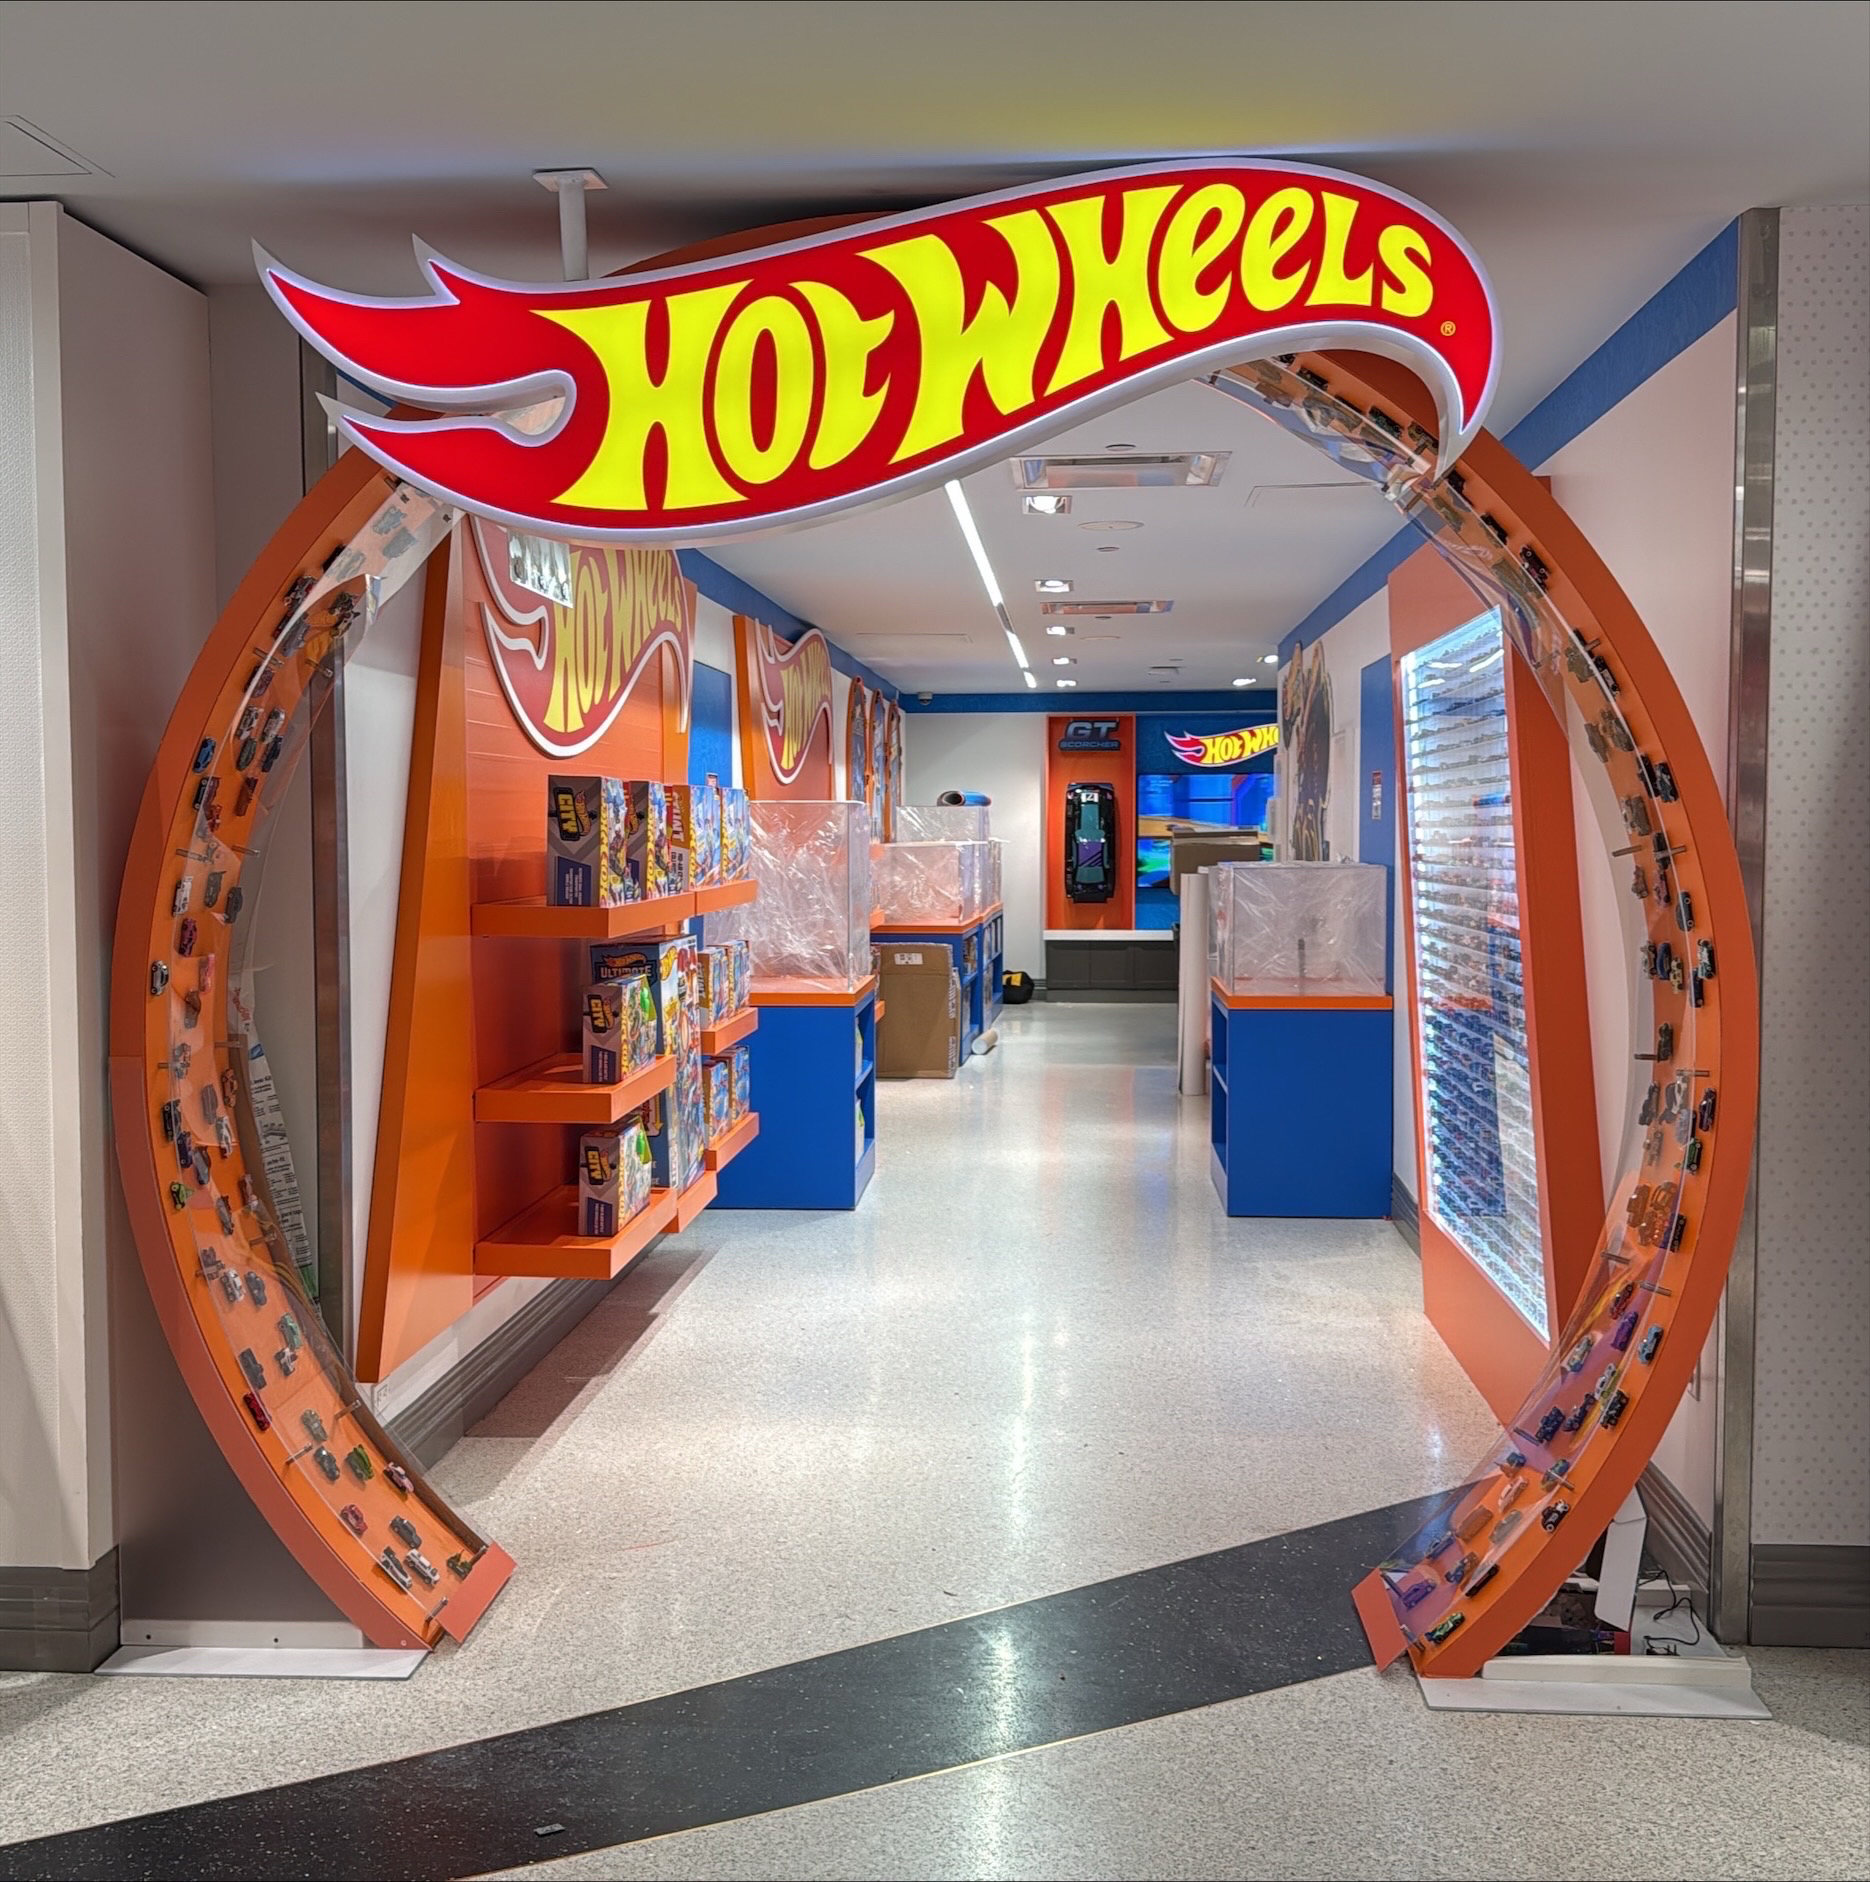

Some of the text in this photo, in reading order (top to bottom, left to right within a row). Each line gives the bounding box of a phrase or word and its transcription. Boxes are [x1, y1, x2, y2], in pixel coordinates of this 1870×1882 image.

[529, 278, 895, 512] HOT
[854, 183, 1435, 466] WHEELS
[1066, 722, 1116, 739] GT
[1200, 736, 1243, 764] HOT
[558, 793, 578, 834] CITY
[591, 999, 605, 1028] CITY
[587, 1151, 601, 1180] CITY
